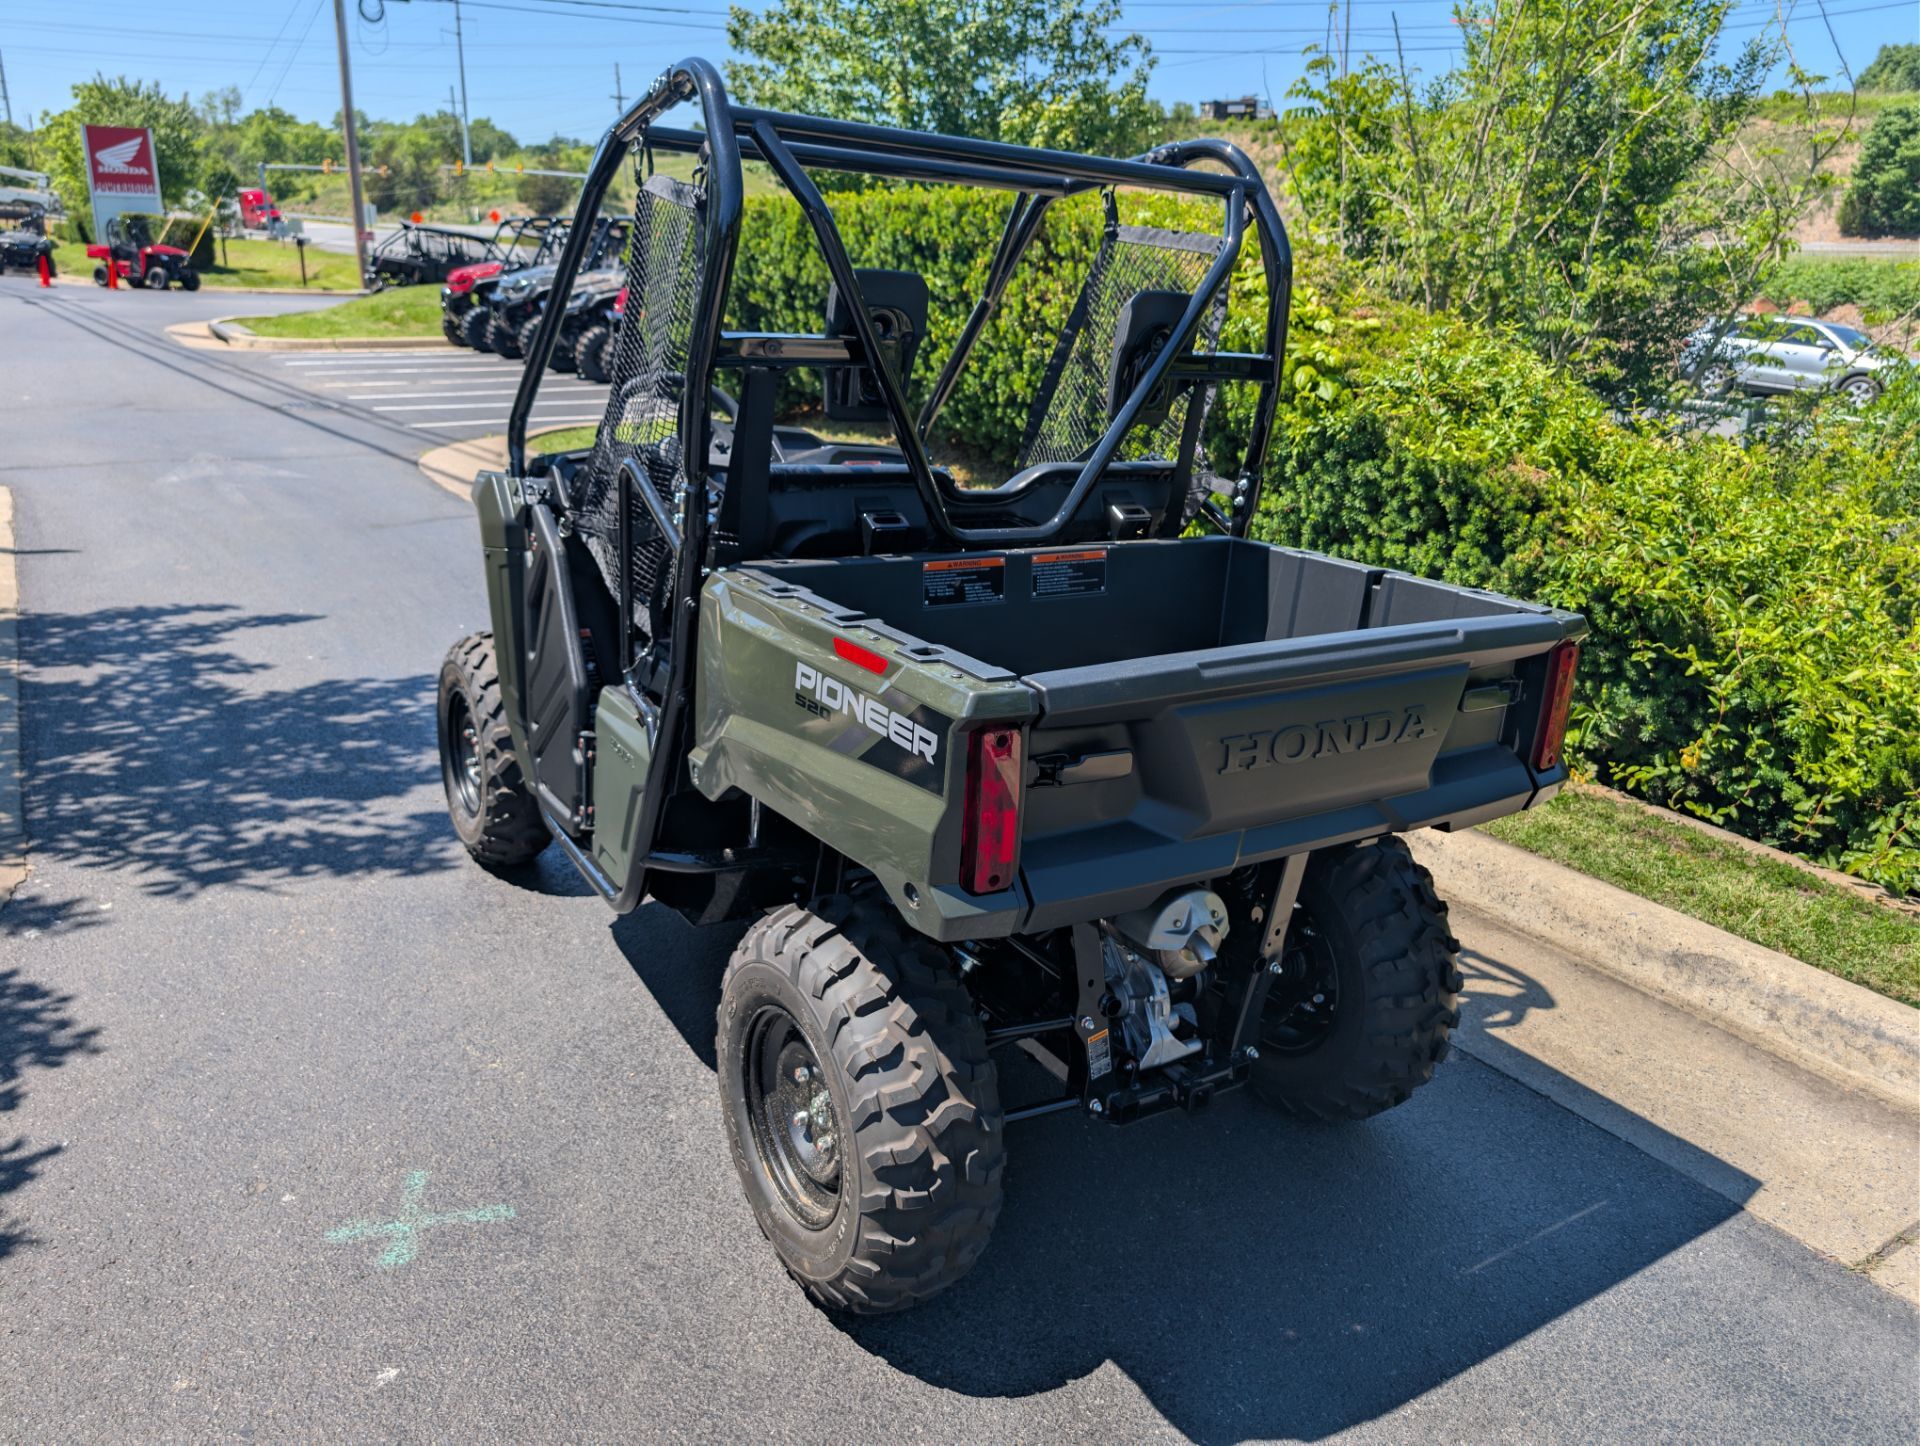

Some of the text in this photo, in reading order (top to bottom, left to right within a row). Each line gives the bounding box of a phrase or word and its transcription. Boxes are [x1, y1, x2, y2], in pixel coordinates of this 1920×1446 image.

[98, 165, 149, 175] HONDA
[795, 692, 832, 721] 520
[795, 662, 938, 764] PIONEER
[1218, 704, 1436, 774] HONDA
